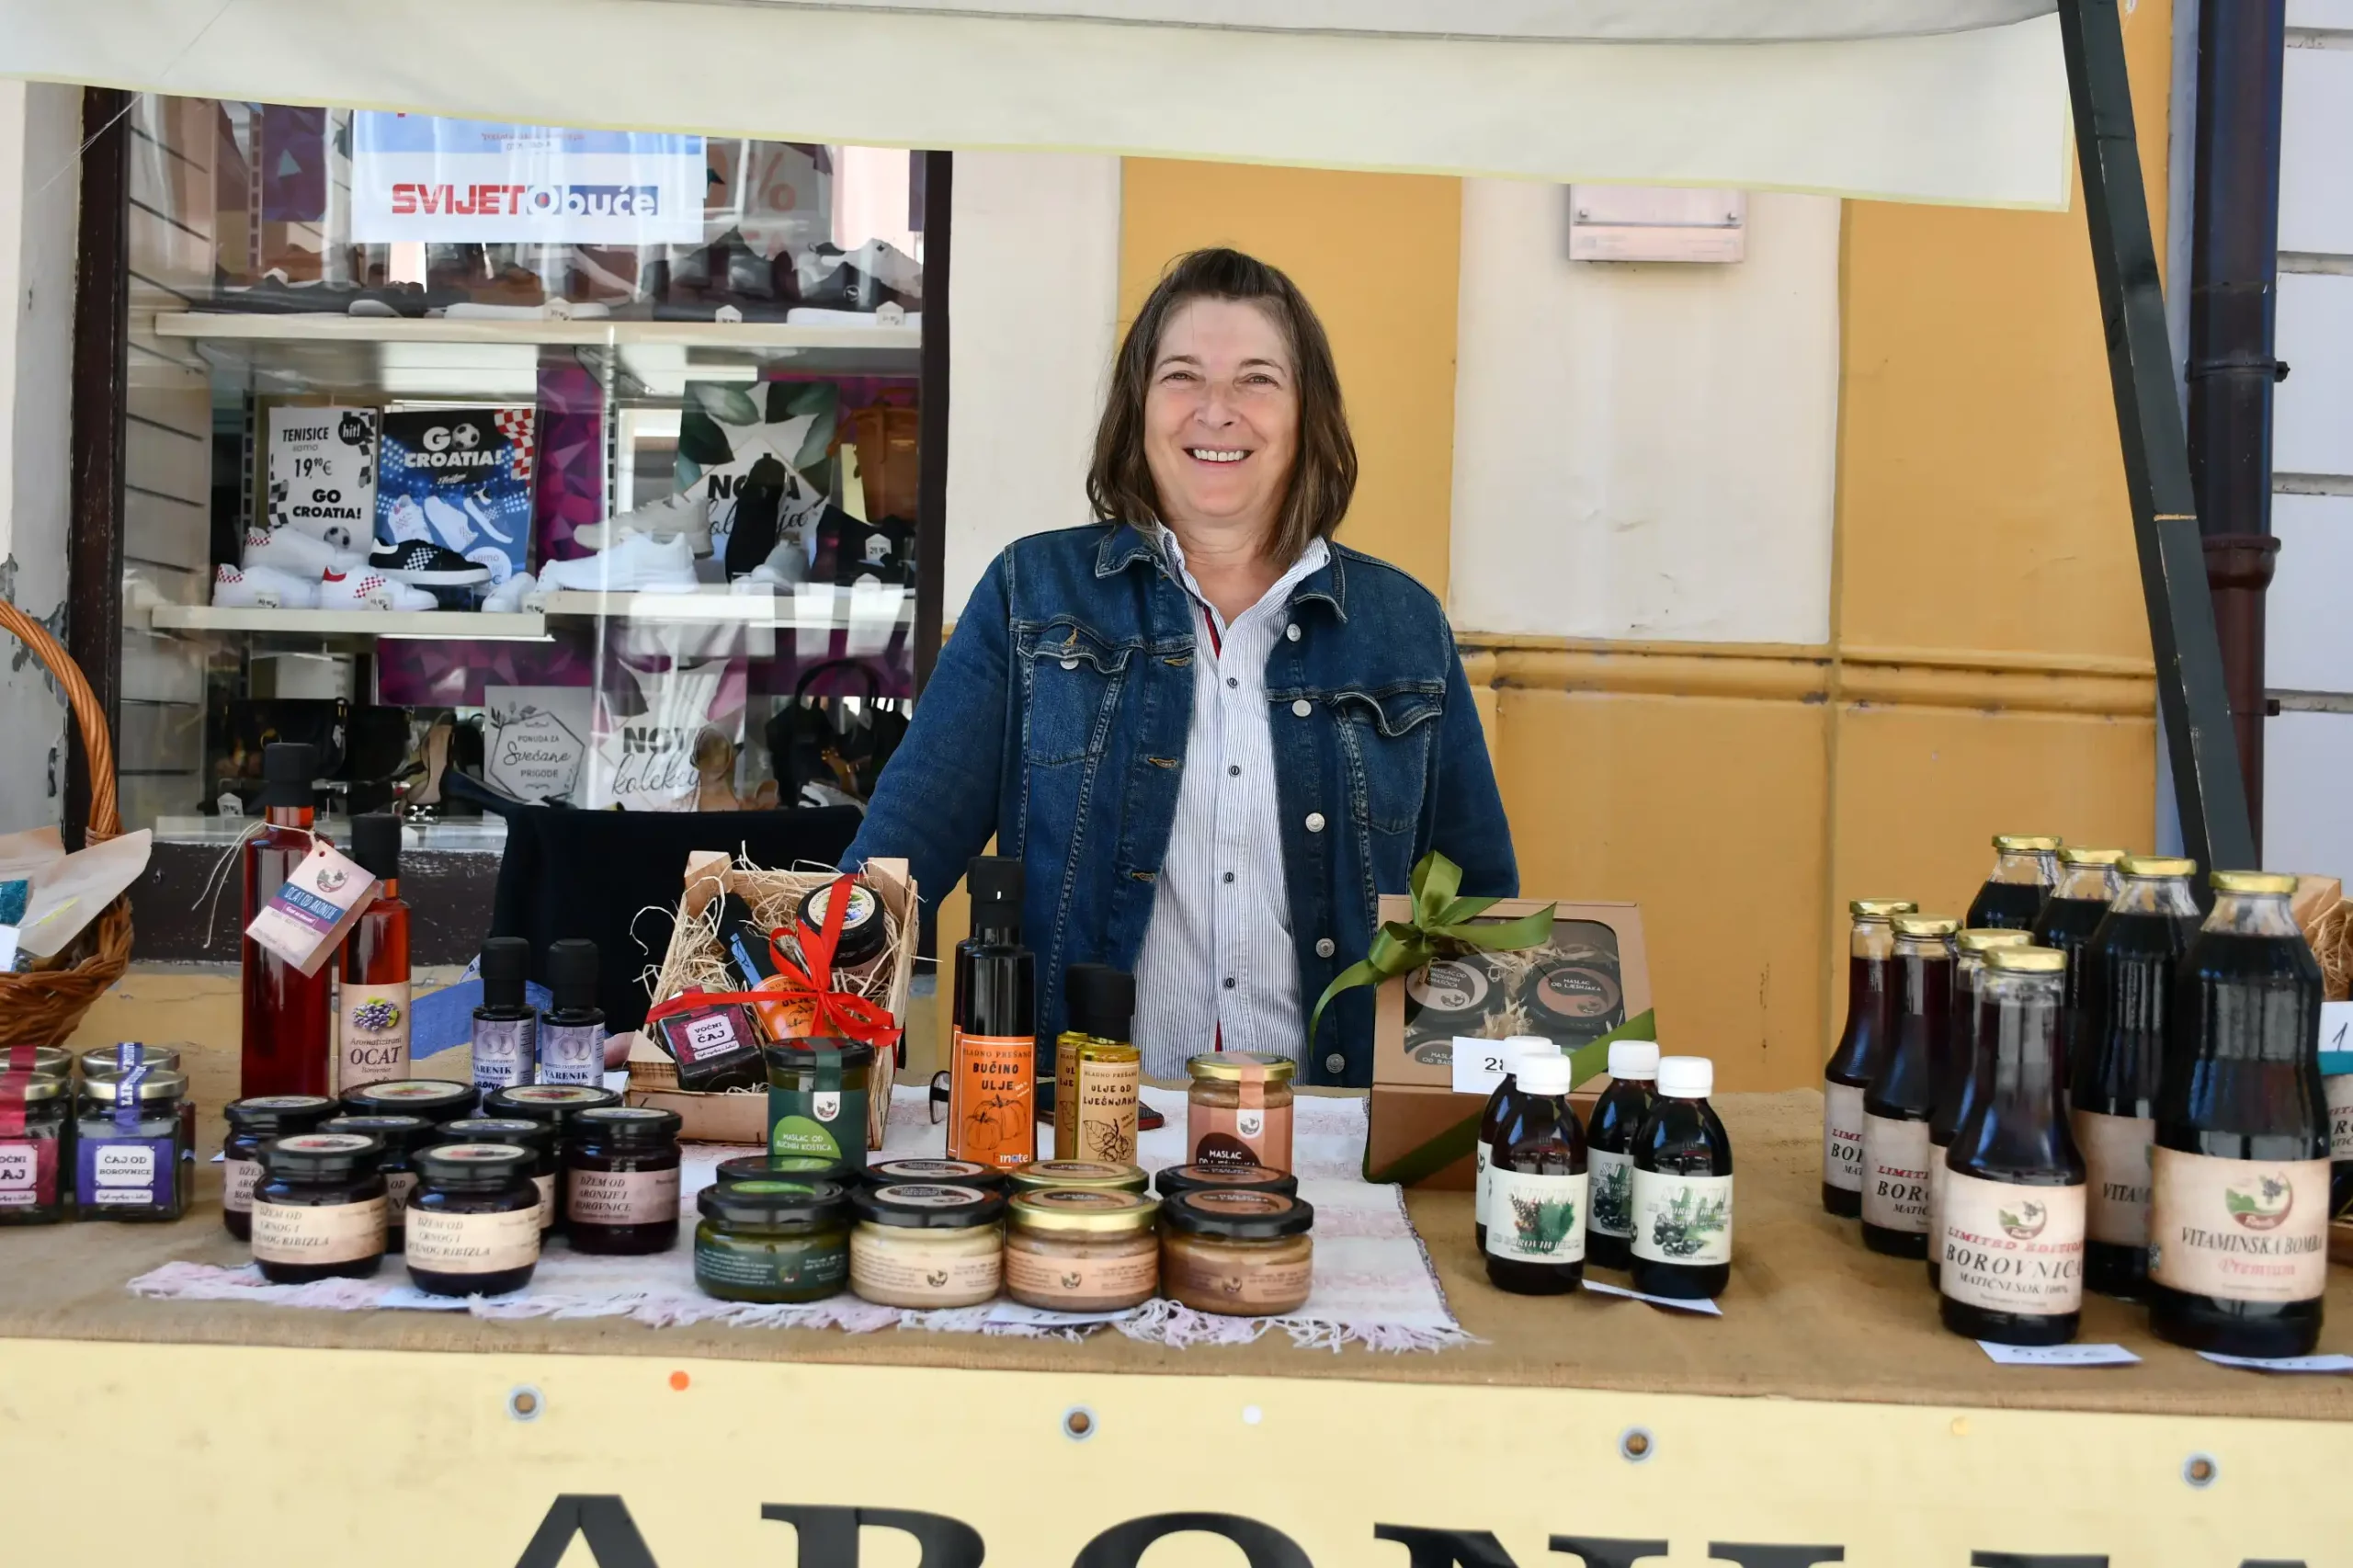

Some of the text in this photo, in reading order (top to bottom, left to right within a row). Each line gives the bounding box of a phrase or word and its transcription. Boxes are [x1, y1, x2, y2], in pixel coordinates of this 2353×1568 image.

[282, 426, 330, 442] TENISICE
[404, 449, 506, 468] CROATIA!
[313, 488, 341, 504] GO
[292, 506, 362, 519] CROATIA!
[350, 1045, 403, 1065] OCAT
[972, 1061, 1019, 1074] BUČINO
[545, 1070, 589, 1080] VARENIK
[982, 1079, 1014, 1091] ULJE
[1090, 1084, 1131, 1093] ULJE OD
[1083, 1096, 1137, 1107] LJEŠNJAKA
[130, 1156, 147, 1165] OD
[1209, 1149, 1243, 1160] MASLAC
[98, 1167, 152, 1176] BOROVNICE
[1947, 1226, 2018, 1251] LIMITED
[2180, 1226, 2281, 1255] VITAMINSKA
[2012, 1282, 2040, 1295] SOK
